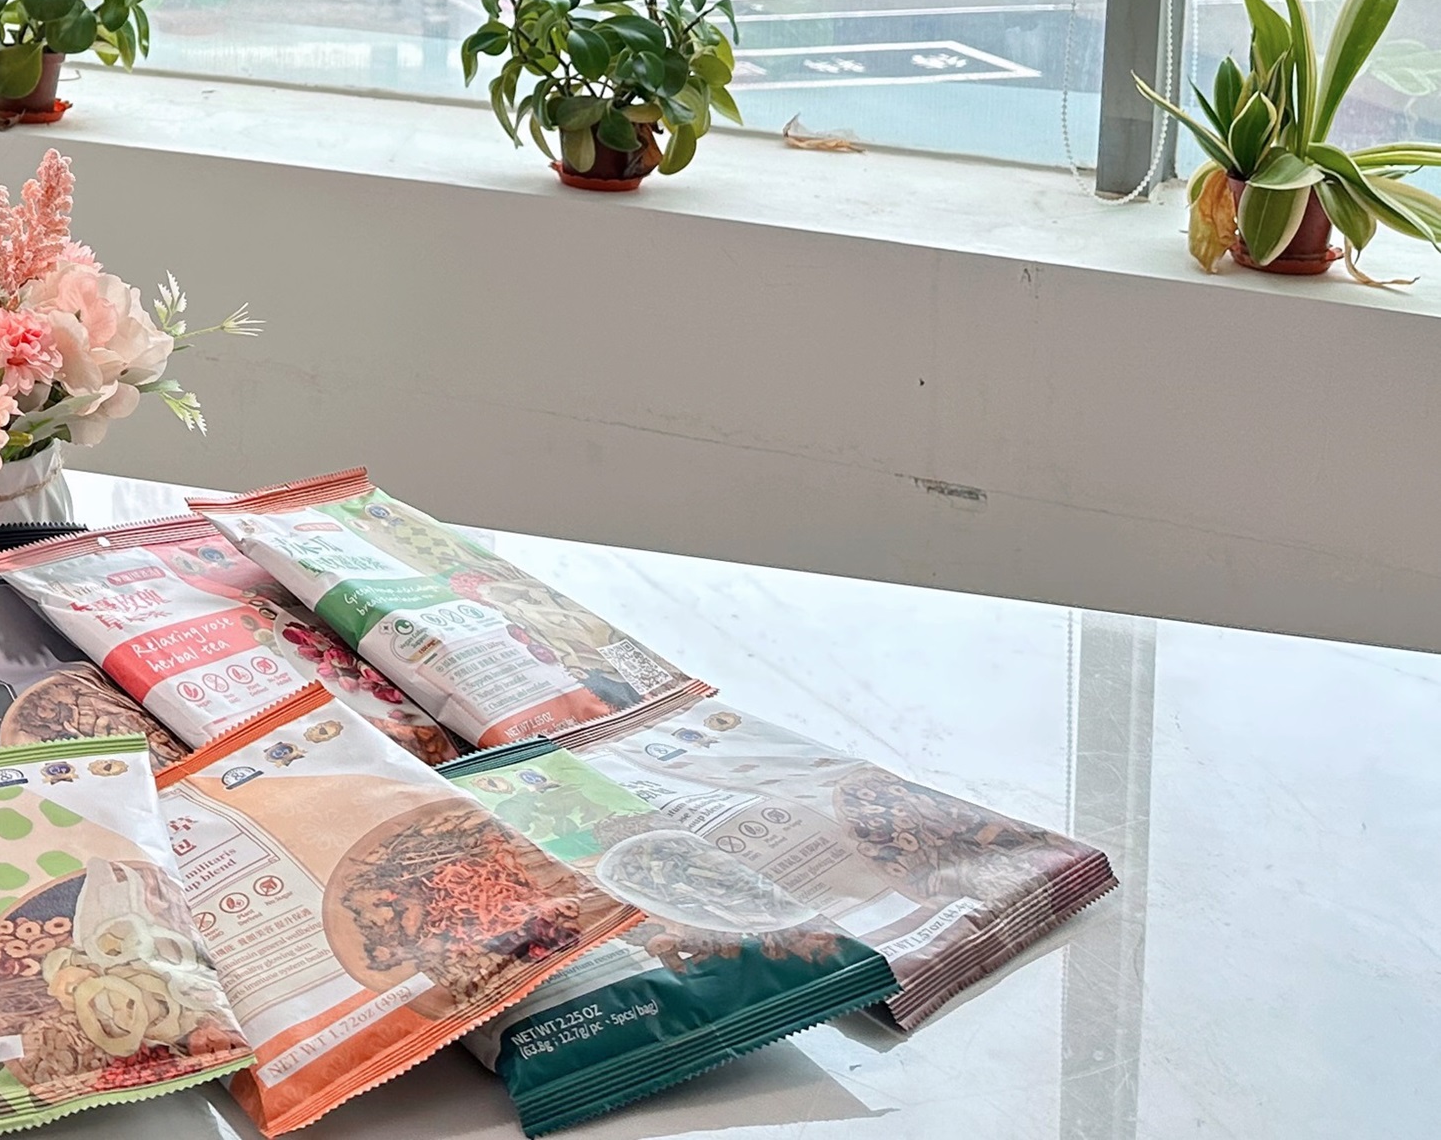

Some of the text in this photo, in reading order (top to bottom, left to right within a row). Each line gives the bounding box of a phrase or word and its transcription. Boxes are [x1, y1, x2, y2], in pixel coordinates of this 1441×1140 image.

[131, 623, 203, 658] Relaxing
[202, 615, 234, 634] rose
[146, 639, 231, 673] herbal tea
[185, 848, 237, 880] militaris
[201, 858, 237, 883] blend
[222, 951, 258, 971] maintain
[278, 960, 306, 976] system
[267, 985, 413, 1079] NET WT 1.72oz (49g)
[511, 1004, 603, 1046] NET WT 2.25 OZ
